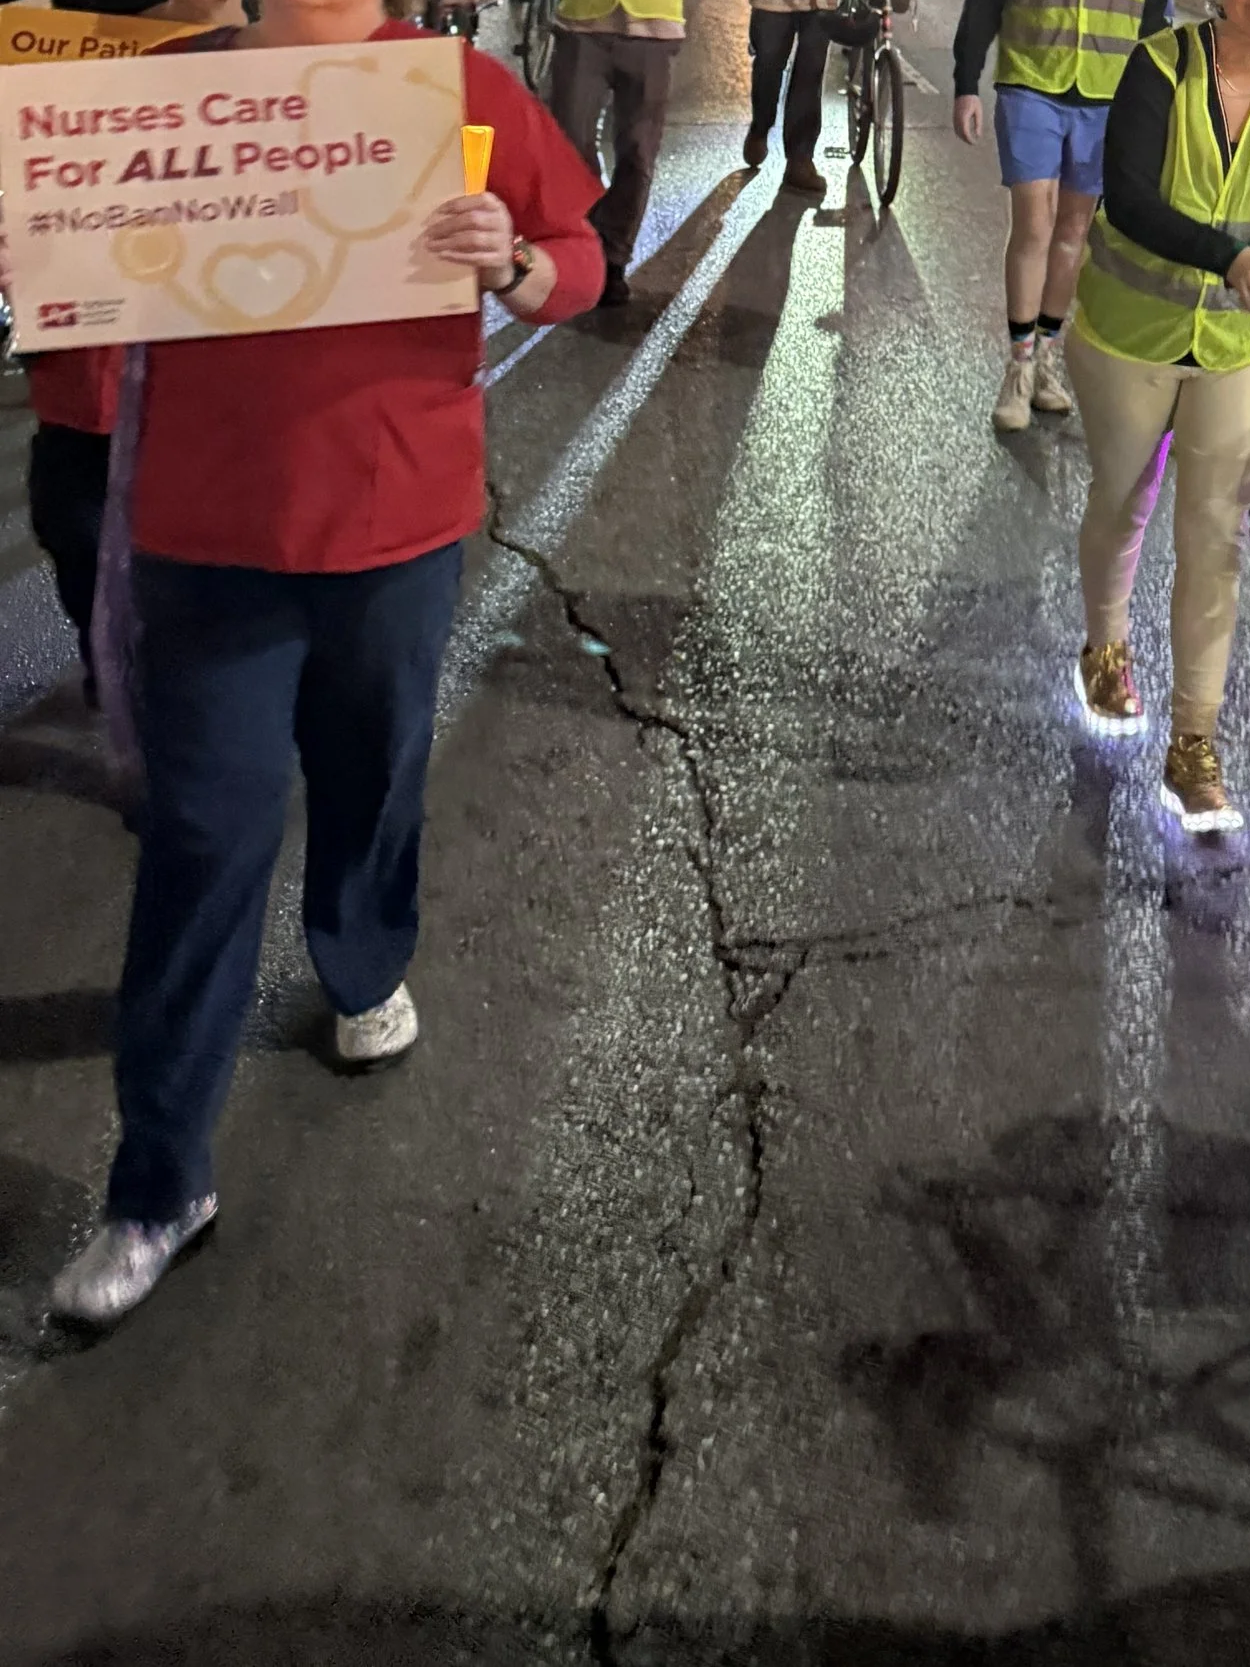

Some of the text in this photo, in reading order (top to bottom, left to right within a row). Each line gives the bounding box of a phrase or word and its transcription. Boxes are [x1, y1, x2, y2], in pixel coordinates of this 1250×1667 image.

[11, 30, 70, 56] Our
[18, 92, 308, 140] Nurses Care
[24, 132, 396, 191] For ALL People
[27, 189, 299, 236] #NoBanNoWall
